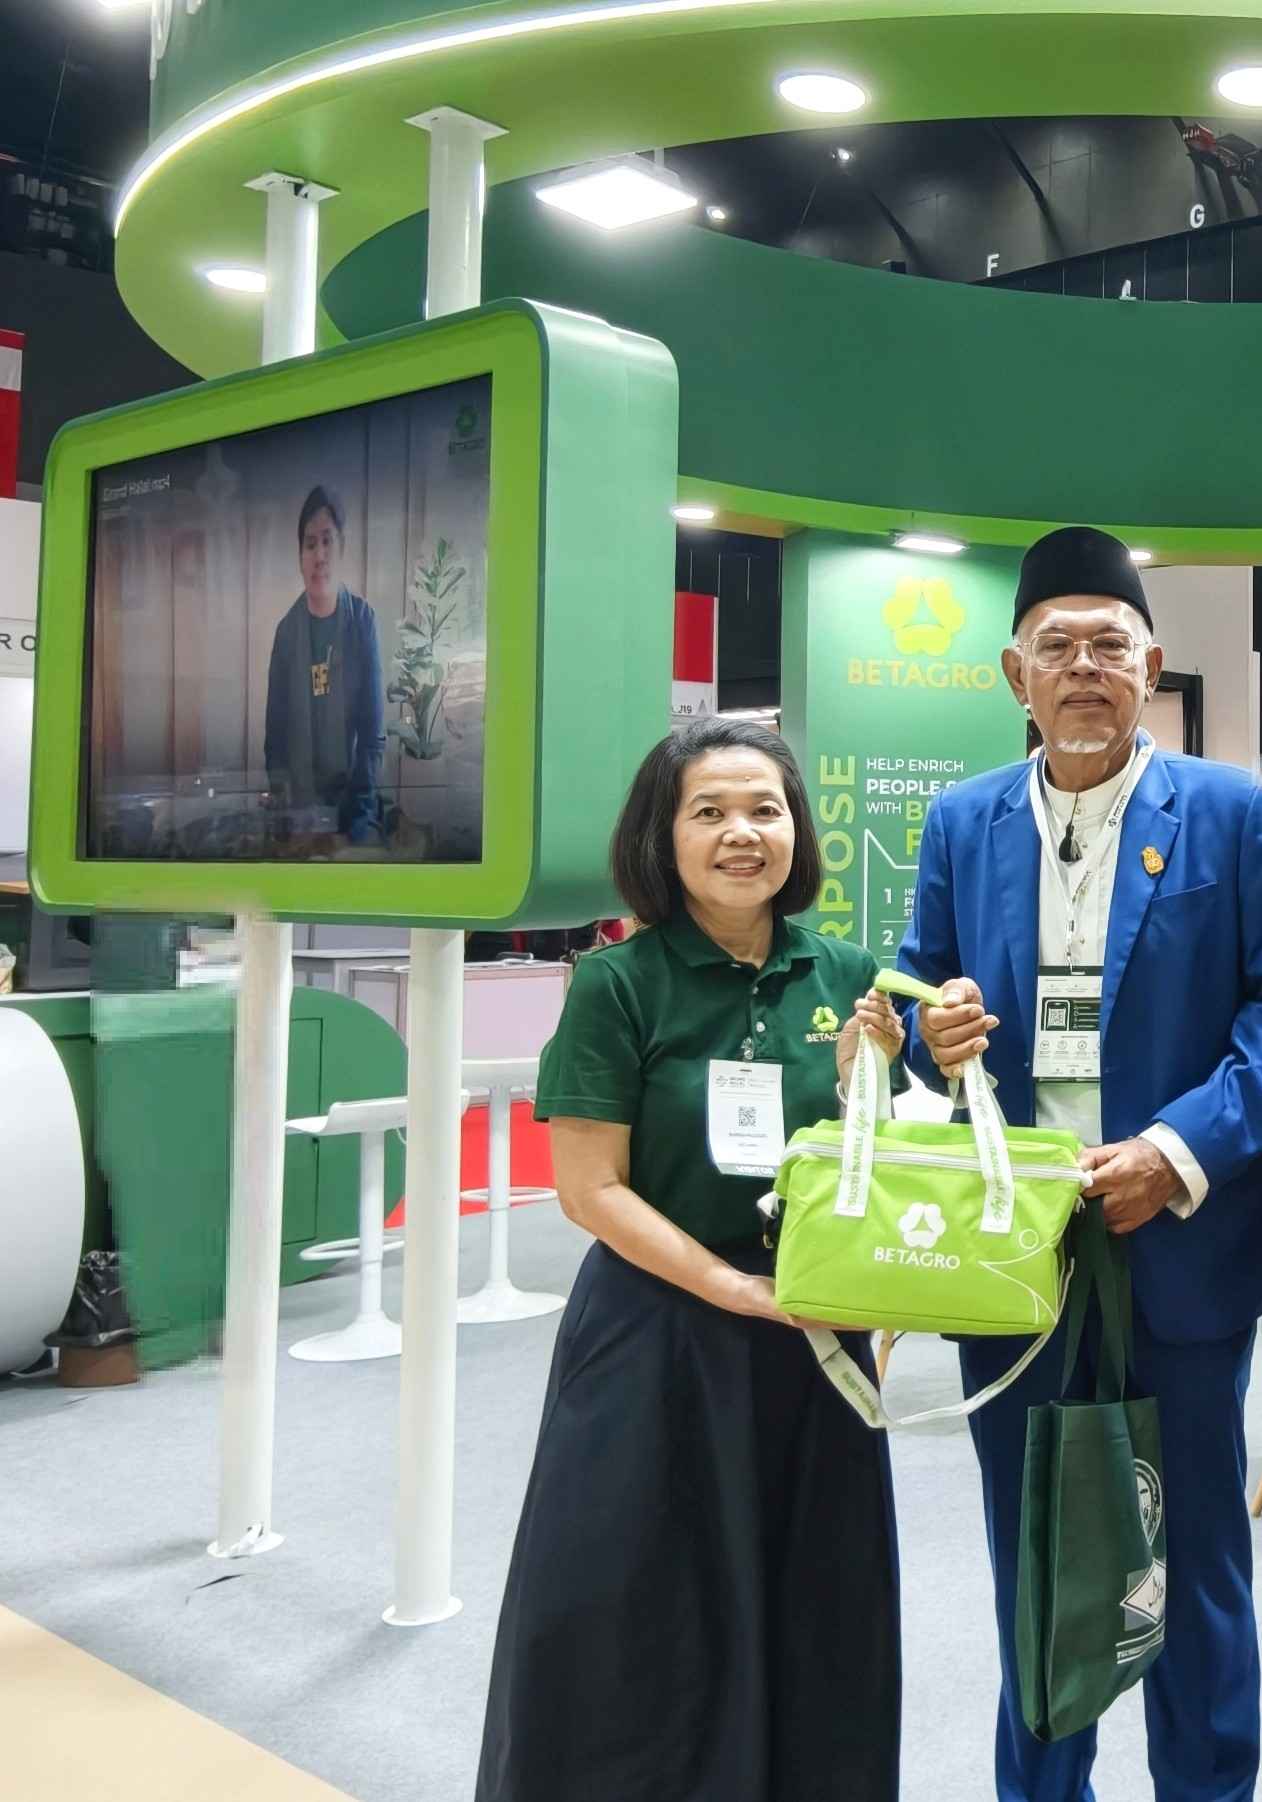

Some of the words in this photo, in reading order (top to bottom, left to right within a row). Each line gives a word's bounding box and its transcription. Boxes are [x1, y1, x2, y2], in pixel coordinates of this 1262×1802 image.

[1190, 203, 1205, 228] G
[987, 254, 999, 277] F
[848, 657, 997, 690] BETAGRO
[866, 758, 905, 770] HELP
[908, 759, 964, 773] ENRICH
[866, 778, 957, 796] PEOPLE
[866, 801, 902, 815] WITH
[817, 755, 856, 939] RPOSE
[883, 888, 892, 904] 1
[882, 929, 894, 946] 2
[806, 1032, 841, 1042] BETAG
[874, 1246, 960, 1270] BETAGRO
